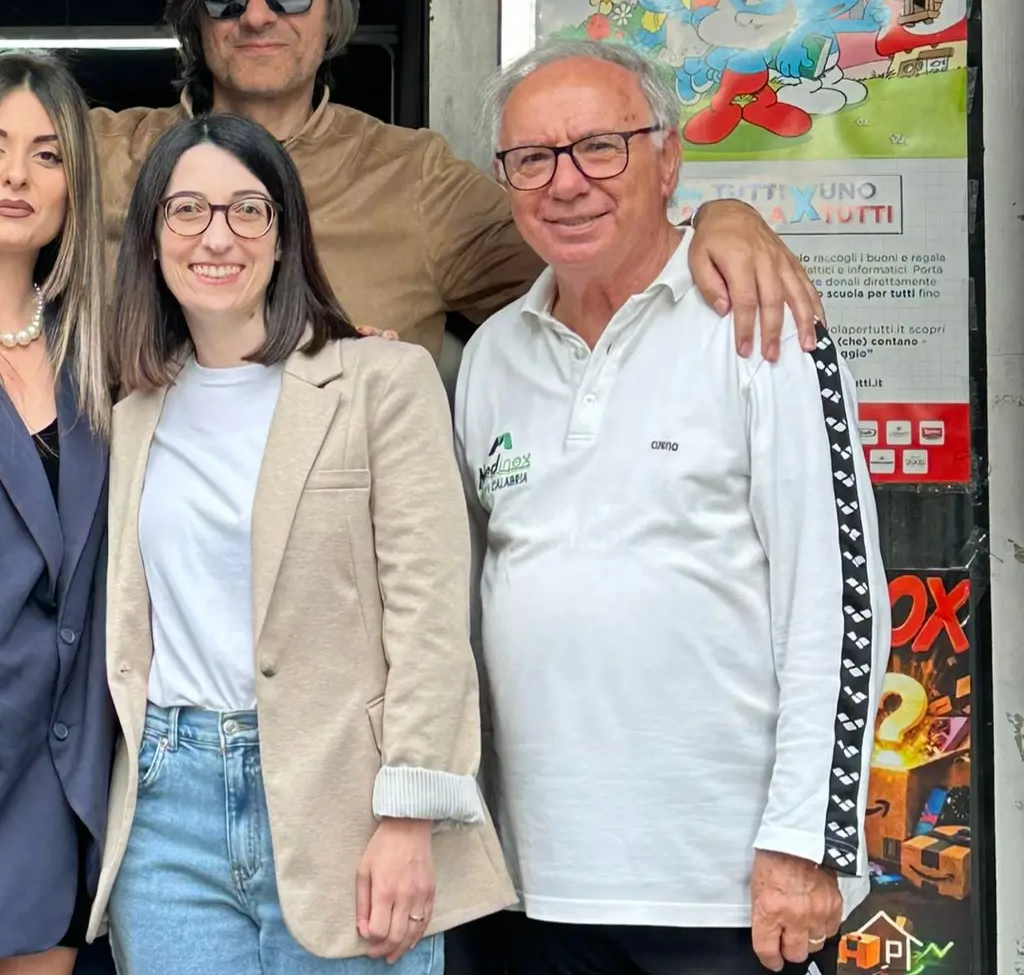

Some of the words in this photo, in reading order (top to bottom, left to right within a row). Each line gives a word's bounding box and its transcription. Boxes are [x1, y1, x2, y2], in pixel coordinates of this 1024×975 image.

[820, 182, 877, 200] UNO
[826, 205, 894, 224] TUTTI
[813, 253, 858, 264] raccogli
[866, 253, 898, 263] buoni
[804, 265, 834, 275] attici
[913, 265, 944, 275] Porta
[825, 277, 860, 287] donali
[863, 277, 937, 287] direttamente
[826, 289, 864, 299] scuola
[891, 289, 915, 298] tutti
[918, 289, 941, 298] fino
[827, 325, 905, 335] olapertutti.it
[909, 325, 946, 335] scopri
[837, 337, 867, 346] (che)
[871, 337, 919, 346] contano
